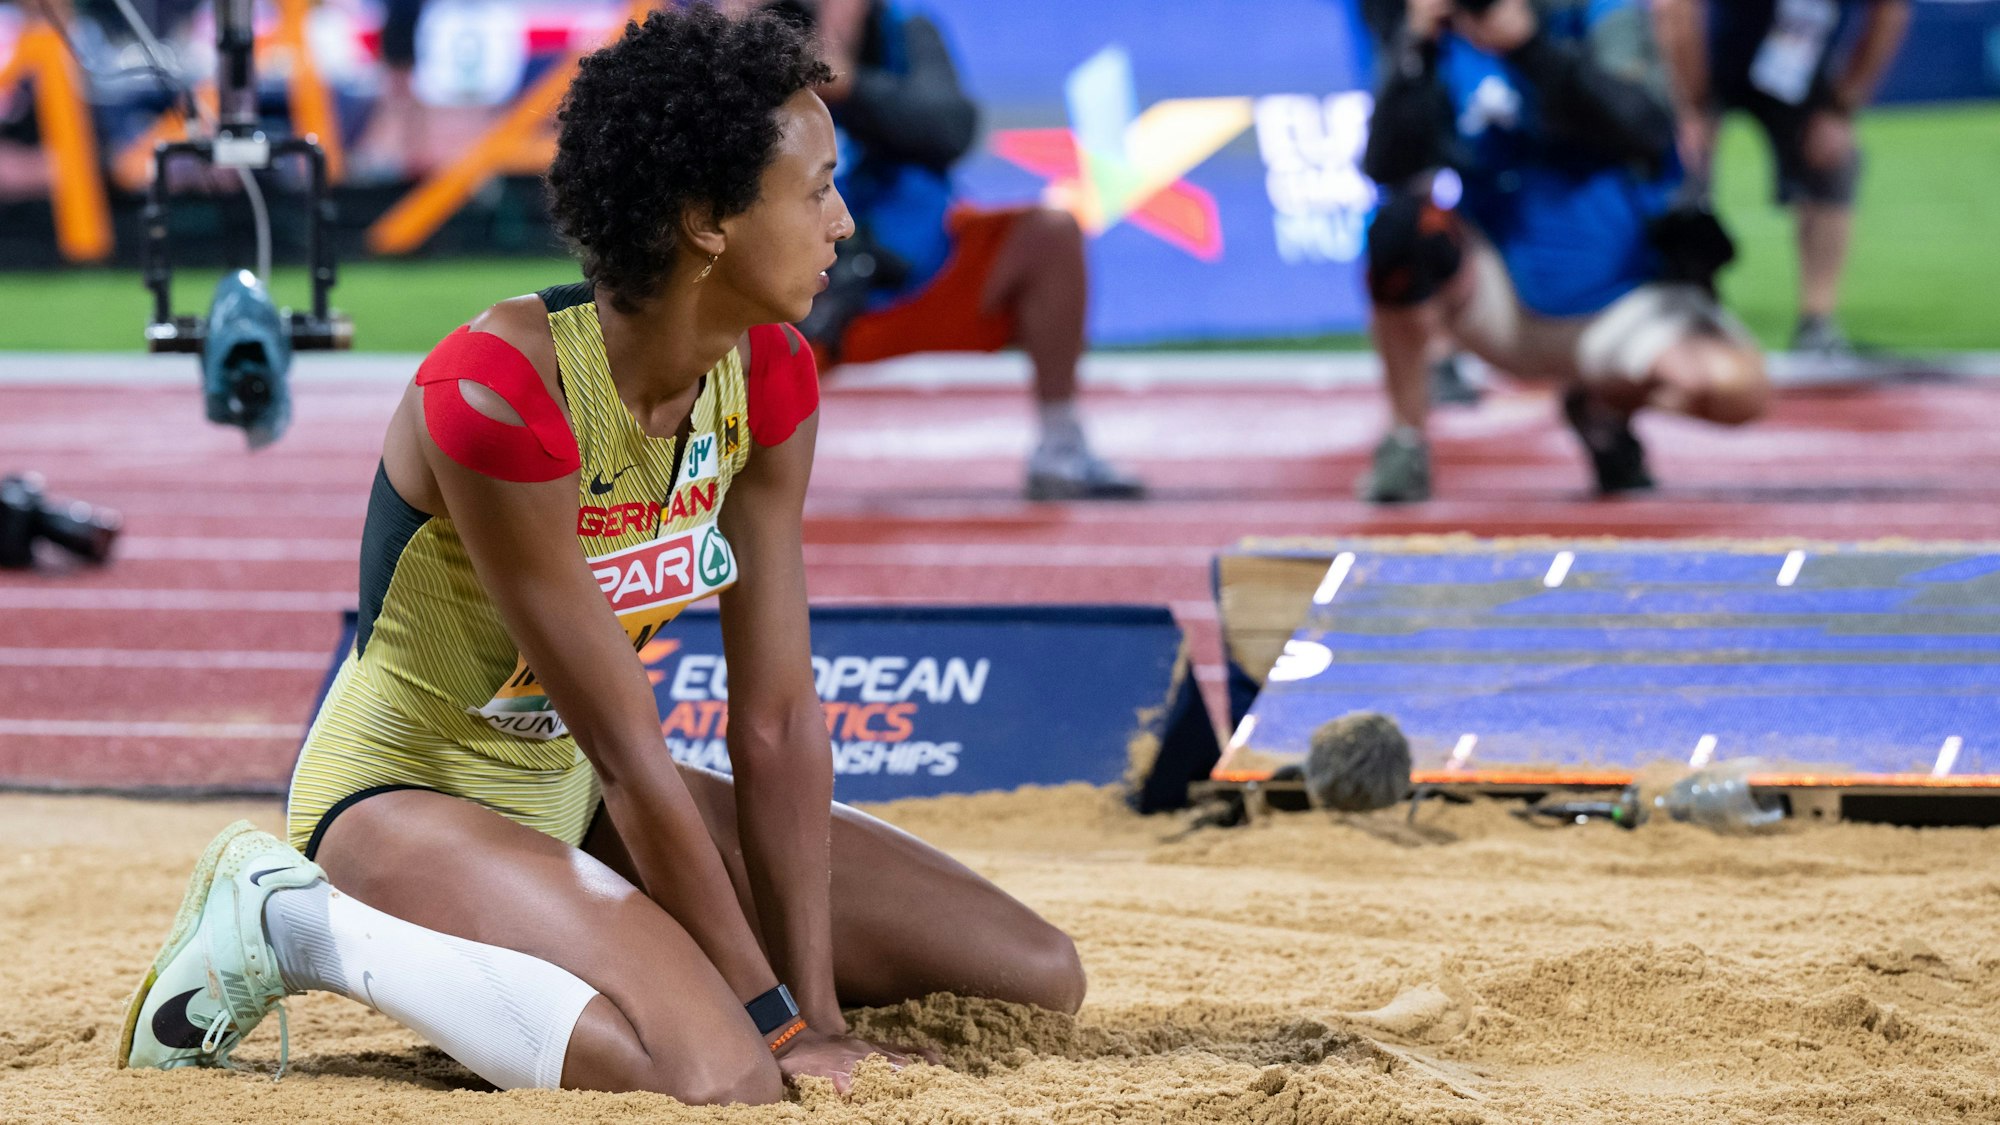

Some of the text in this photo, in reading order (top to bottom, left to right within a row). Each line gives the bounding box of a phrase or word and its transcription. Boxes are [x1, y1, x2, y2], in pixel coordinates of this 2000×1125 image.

[592, 546, 691, 603] PAR
[670, 655, 990, 704] EPEAN
[661, 702, 918, 742] ATTICS
[220, 970, 260, 1020] NIKE
